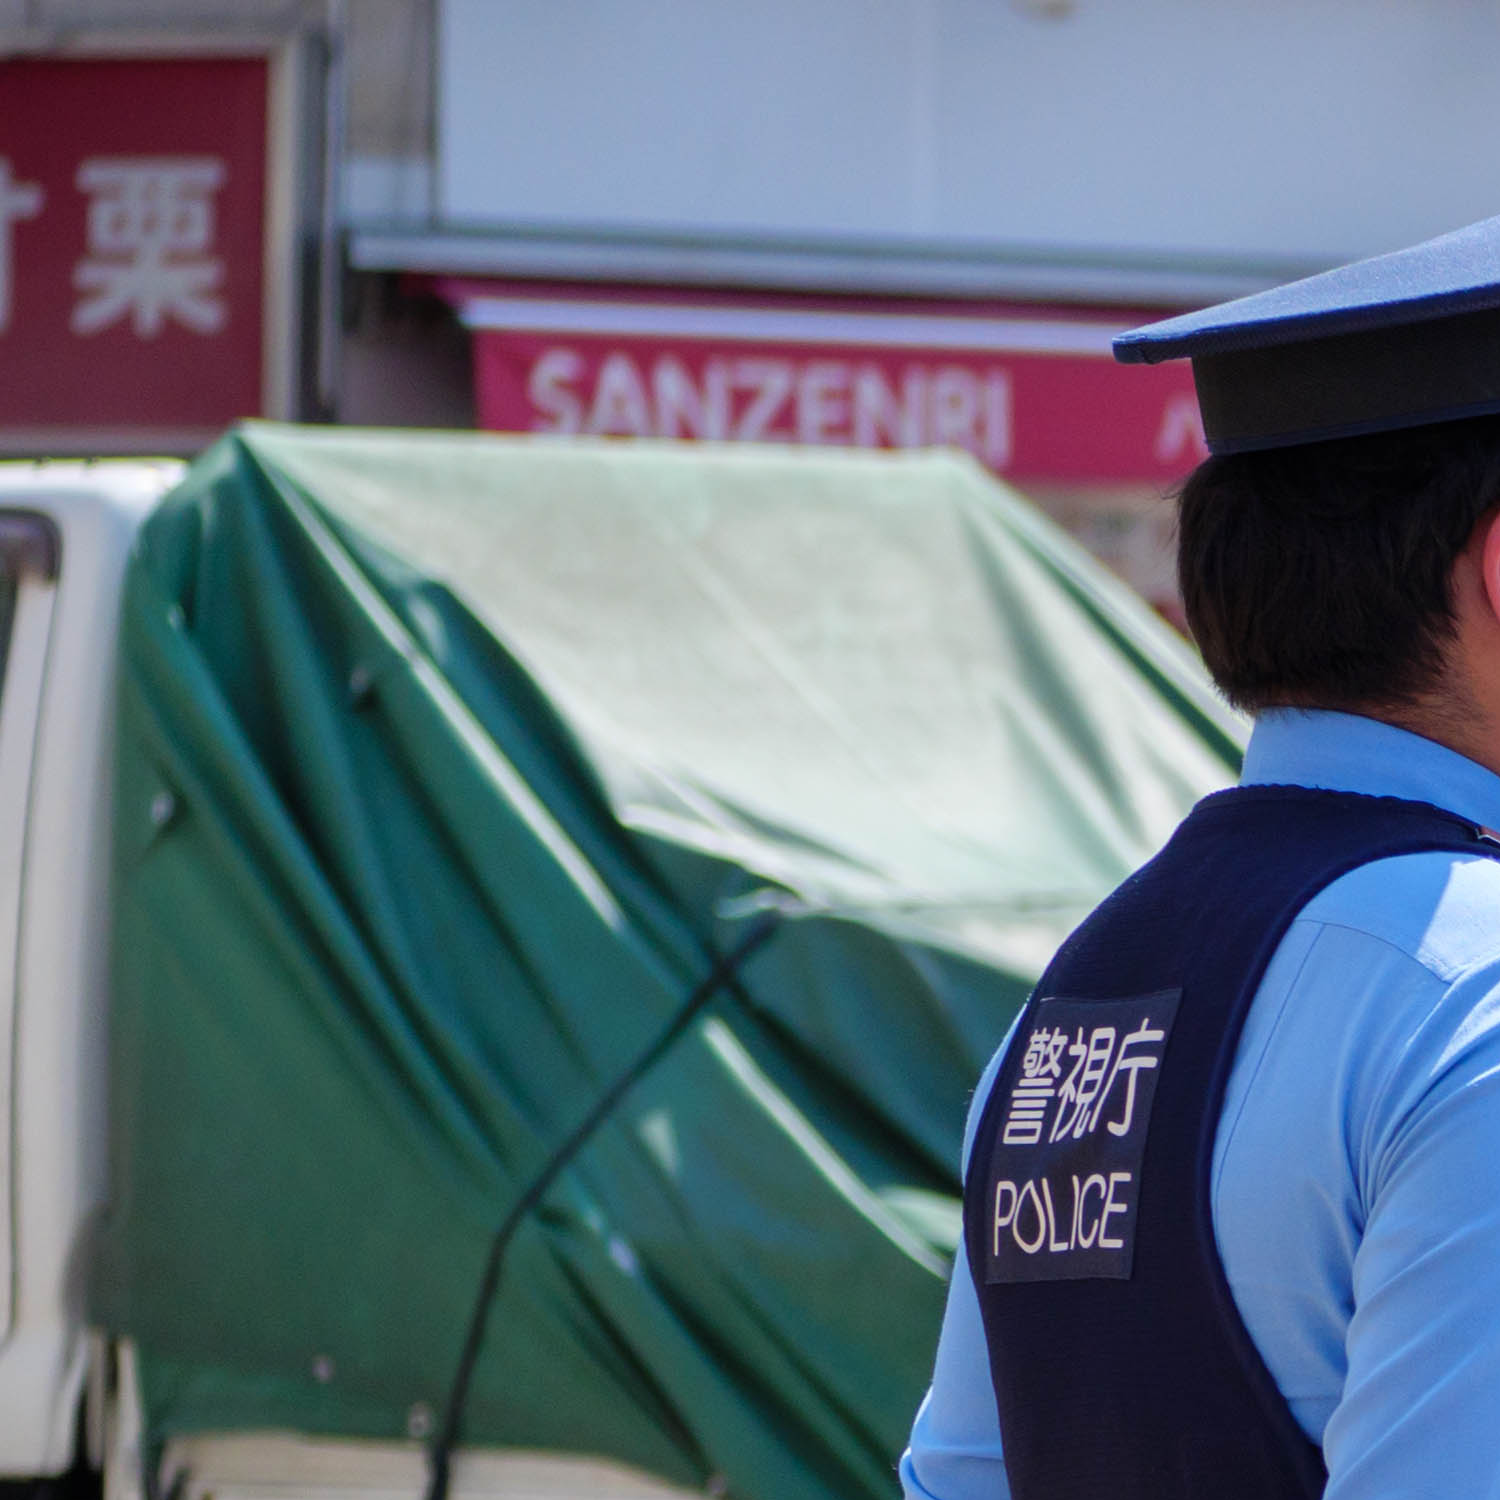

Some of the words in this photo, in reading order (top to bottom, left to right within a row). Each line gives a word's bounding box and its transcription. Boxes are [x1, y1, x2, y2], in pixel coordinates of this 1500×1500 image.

[528, 348, 1014, 470] SANZENRI
[1003, 1017, 1165, 1145] 警視庁
[994, 1171, 1132, 1256] POLICE
